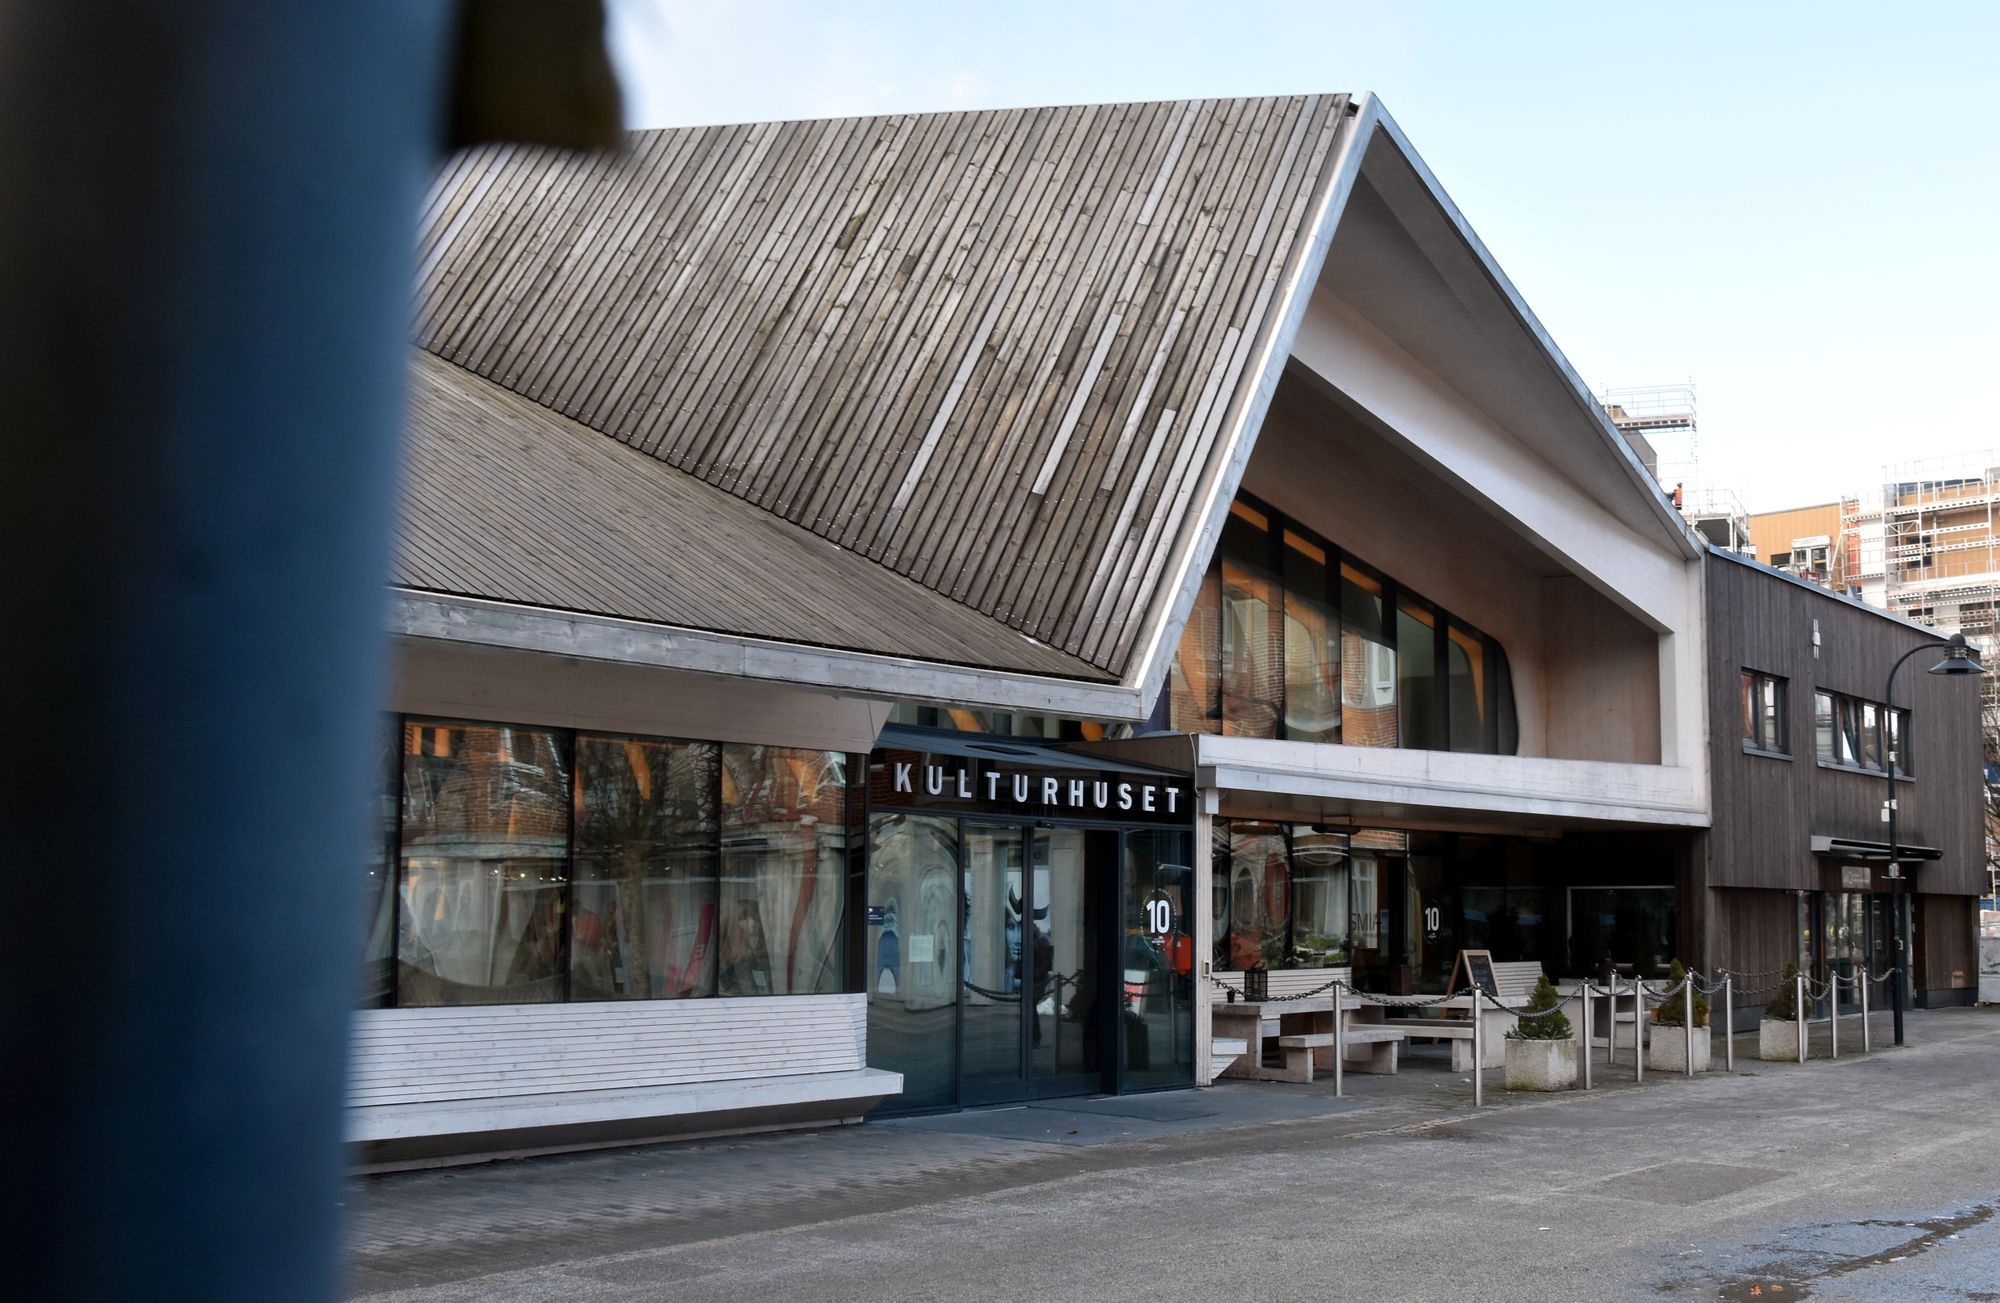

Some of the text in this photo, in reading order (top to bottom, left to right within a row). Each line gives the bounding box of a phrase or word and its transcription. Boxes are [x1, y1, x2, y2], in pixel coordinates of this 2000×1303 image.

[894, 762, 1179, 813] KULTURHUSET
[1146, 900, 1170, 934] 10
[1424, 907, 1440, 932] 10
